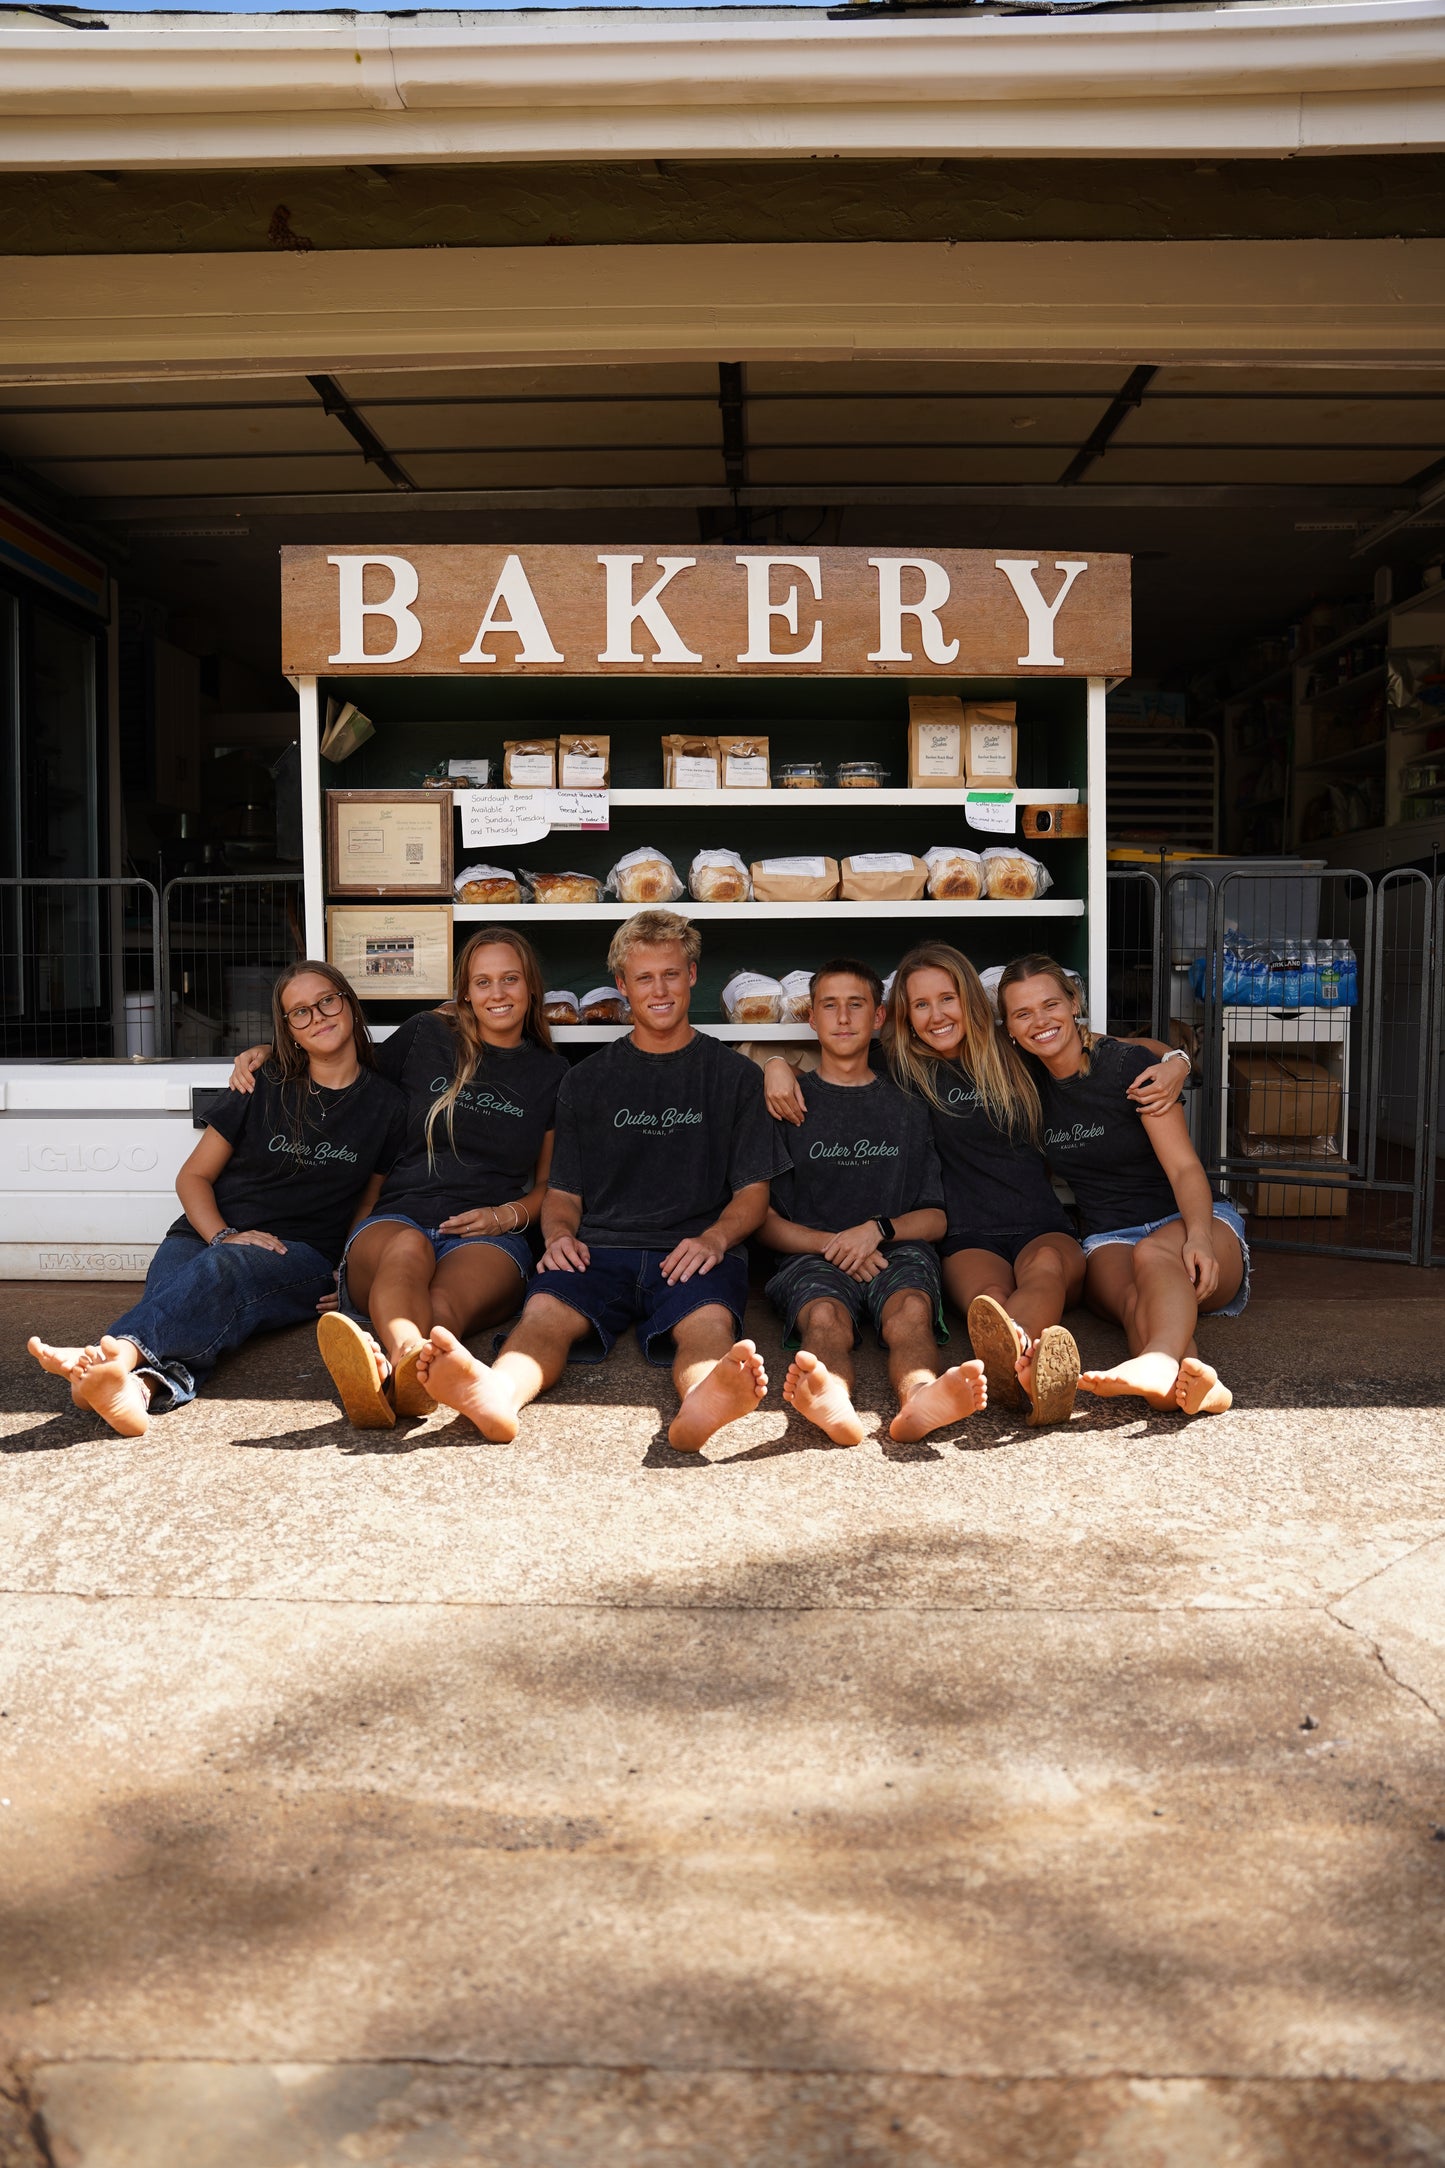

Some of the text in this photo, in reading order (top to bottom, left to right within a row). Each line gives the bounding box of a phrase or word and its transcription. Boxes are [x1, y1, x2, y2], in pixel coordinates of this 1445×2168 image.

[327, 553, 1089, 668] BAKERY
[471, 794, 509, 805] Sourdough
[516, 814, 546, 824] Tuesday
[486, 827, 518, 836] Thursday
[430, 1076, 524, 1118] Ouer Bakes
[614, 1107, 703, 1128] Outer Bakes
[1044, 1122, 1104, 1146] Outer Bakes
[314, 1142, 358, 1163] Bakes
[809, 1139, 900, 1159] Outer Bakes
[39, 1253, 151, 1271] MAXCOLD
